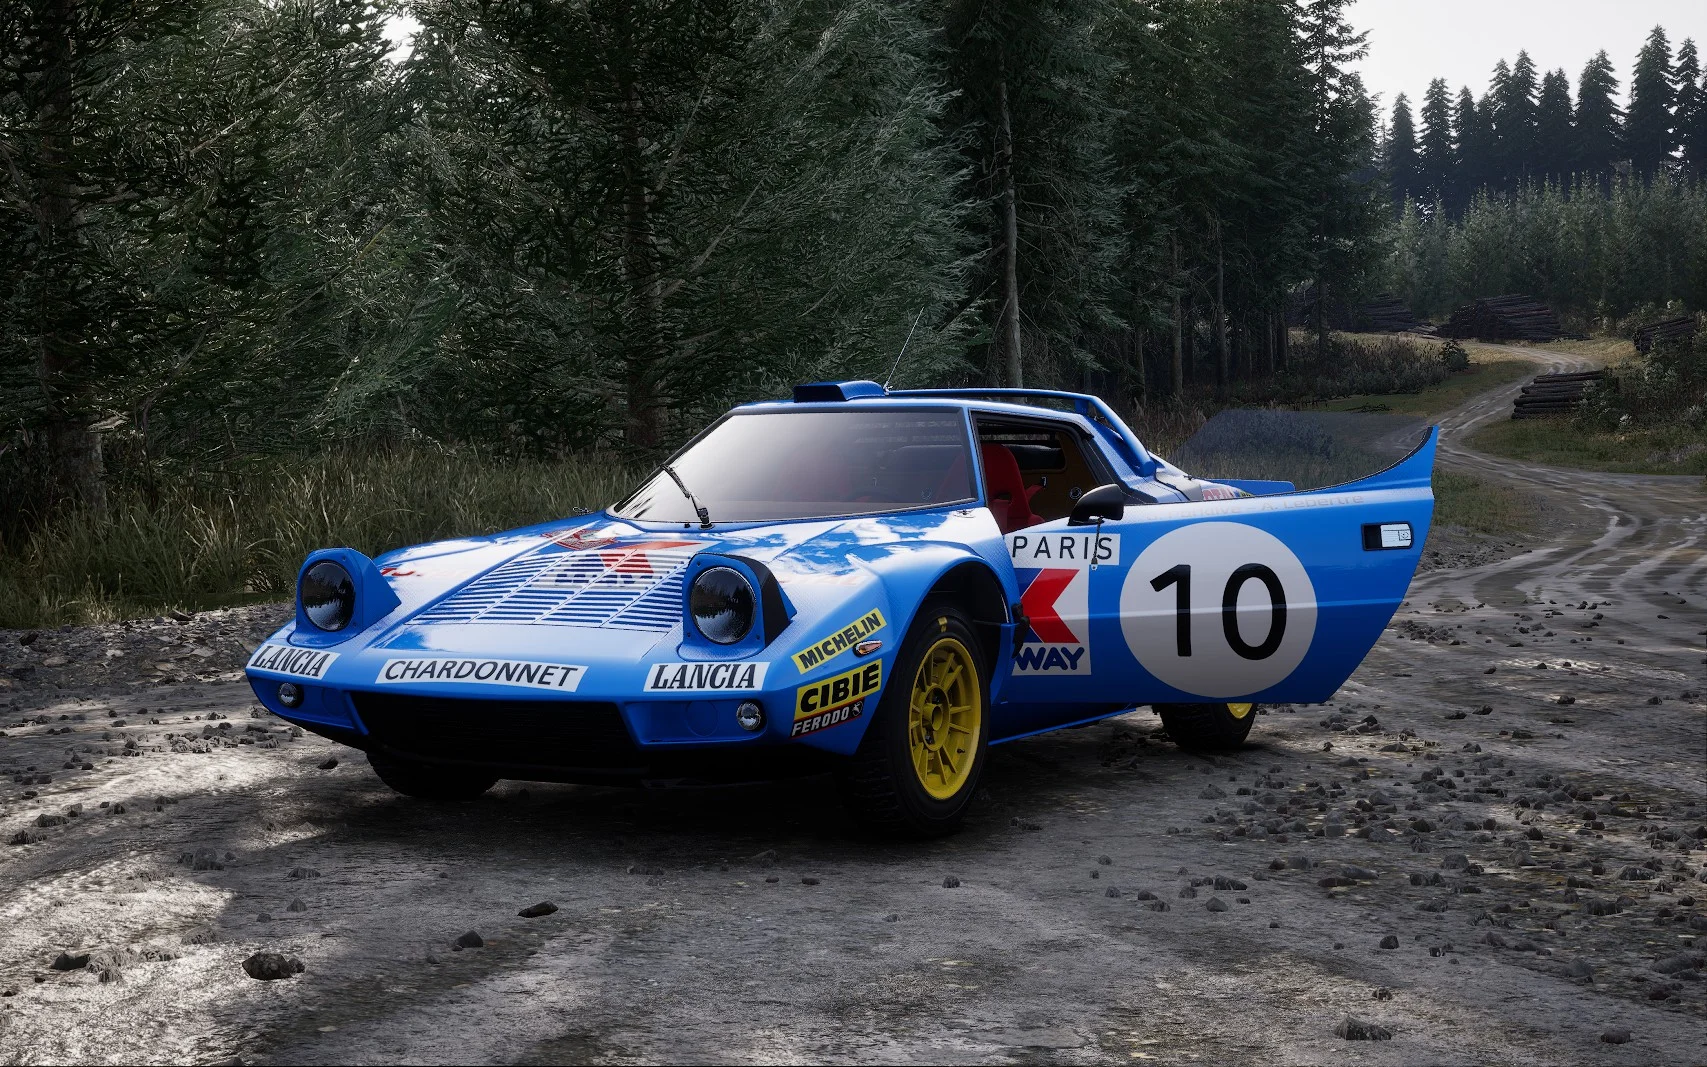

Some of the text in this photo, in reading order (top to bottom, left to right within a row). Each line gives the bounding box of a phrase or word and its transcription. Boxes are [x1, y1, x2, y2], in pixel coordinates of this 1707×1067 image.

[1012, 535, 1113, 560] PARIS
[1150, 563, 1287, 660] 10
[798, 612, 882, 670] MICHELIN
[251, 645, 330, 677] LANCIA
[385, 660, 578, 687] CHARDONNET
[1014, 646, 1084, 670] WAY
[651, 663, 756, 689] LANCIA
[800, 663, 880, 713] CIBIÉ
[791, 706, 849, 737] FERODO
